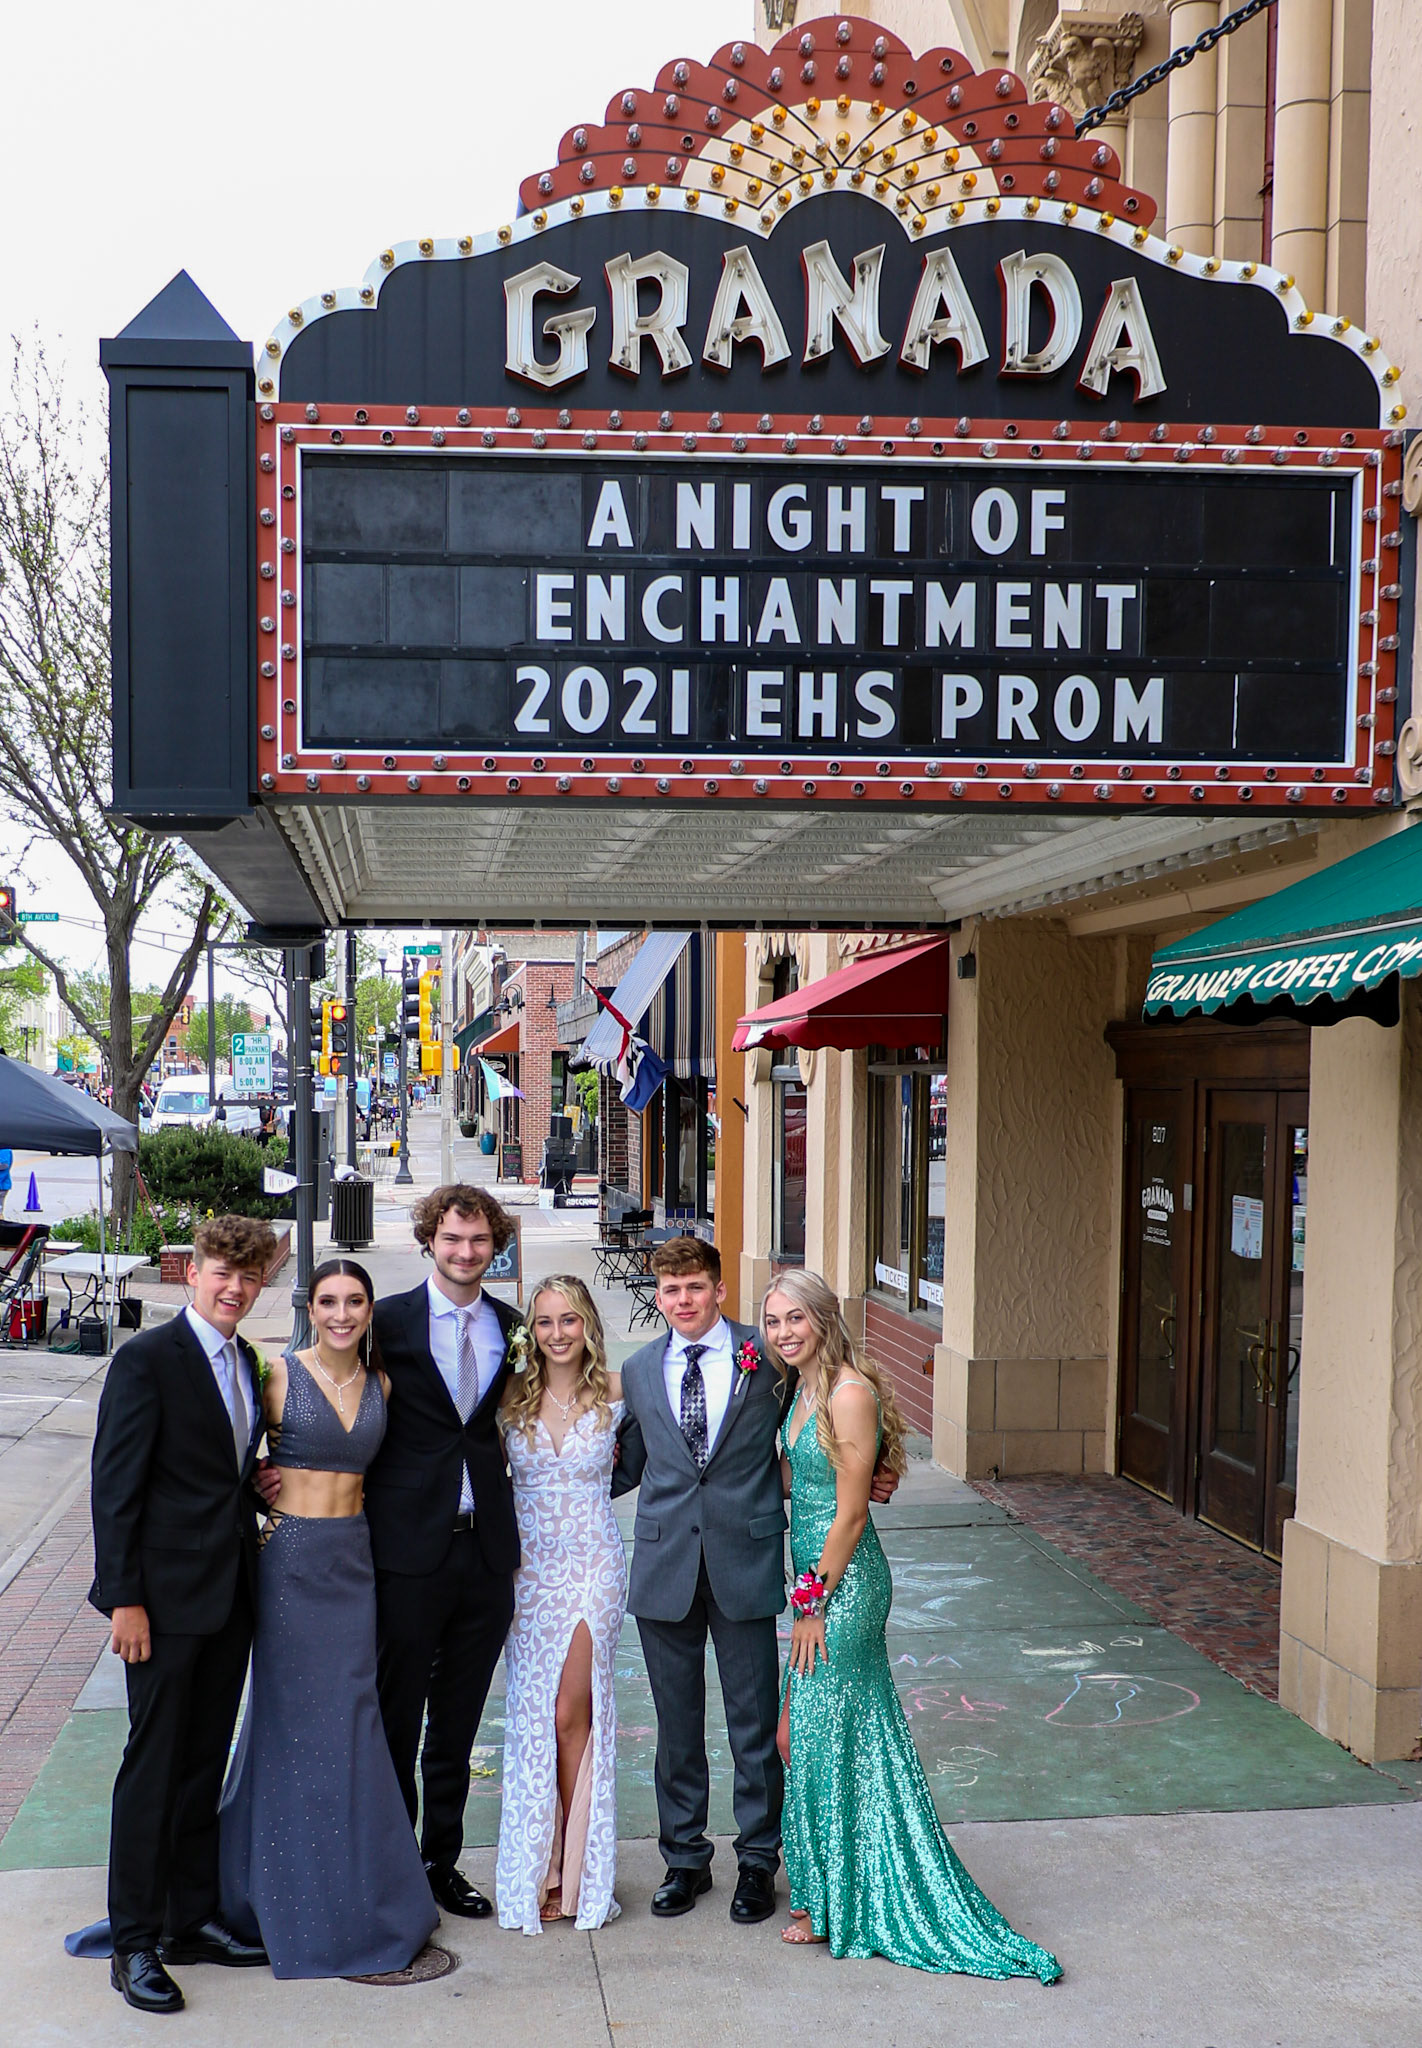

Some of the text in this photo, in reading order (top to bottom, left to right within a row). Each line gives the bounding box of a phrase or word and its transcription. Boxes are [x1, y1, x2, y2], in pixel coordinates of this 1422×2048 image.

[502, 238, 1169, 405] GRANADA
[587, 480, 1066, 555] A NIGHT OF
[536, 573, 1137, 651] ENCHANTMENT
[513, 665, 1164, 743] 2021 EHS PROM
[34, 913, 56, 921] AVENUE
[1248, 950, 1359, 990] COFFEE
[234, 1037, 244, 1053] 2
[245, 1046, 270, 1054] PARKING
[239, 1056, 265, 1066] 8:00 AM
[248, 1067, 257, 1076] TO
[239, 1077, 254, 1087] 5:00
[255, 1077, 266, 1086] PM
[1152, 1126, 1167, 1144] 807
[1141, 1184, 1175, 1214] GRANADA
[884, 1268, 908, 1289] TICKETS
